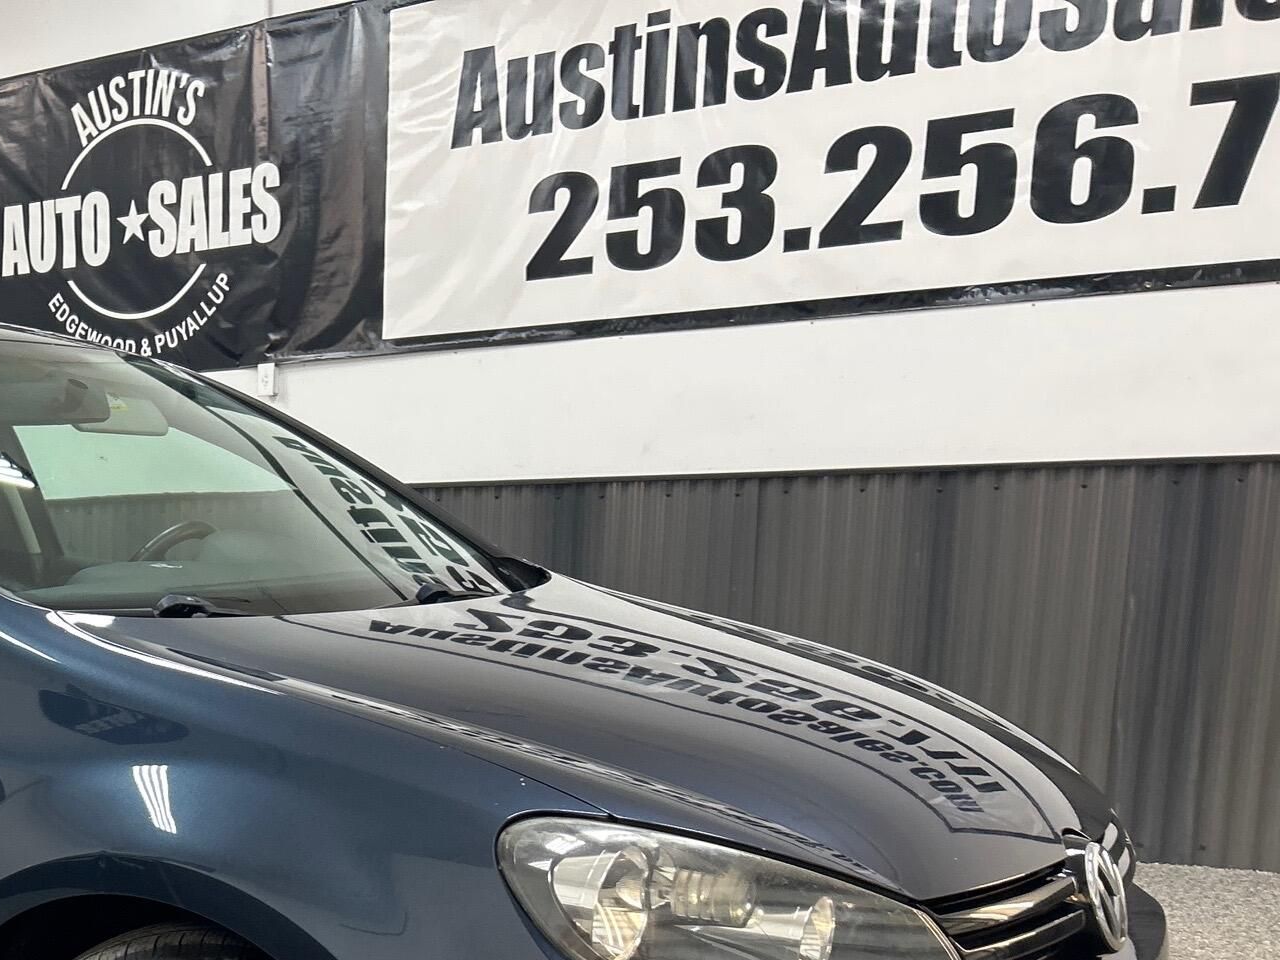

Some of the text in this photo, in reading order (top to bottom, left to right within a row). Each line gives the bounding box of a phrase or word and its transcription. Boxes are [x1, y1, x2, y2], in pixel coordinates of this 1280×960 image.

[71, 69, 205, 147] AUSTIN'S
[2, 162, 281, 277] AUTO SALES
[526, 73, 1280, 281] 253.256.7
[140, 338, 152, 357] &
[154, 272, 231, 354] PUYALLUP
